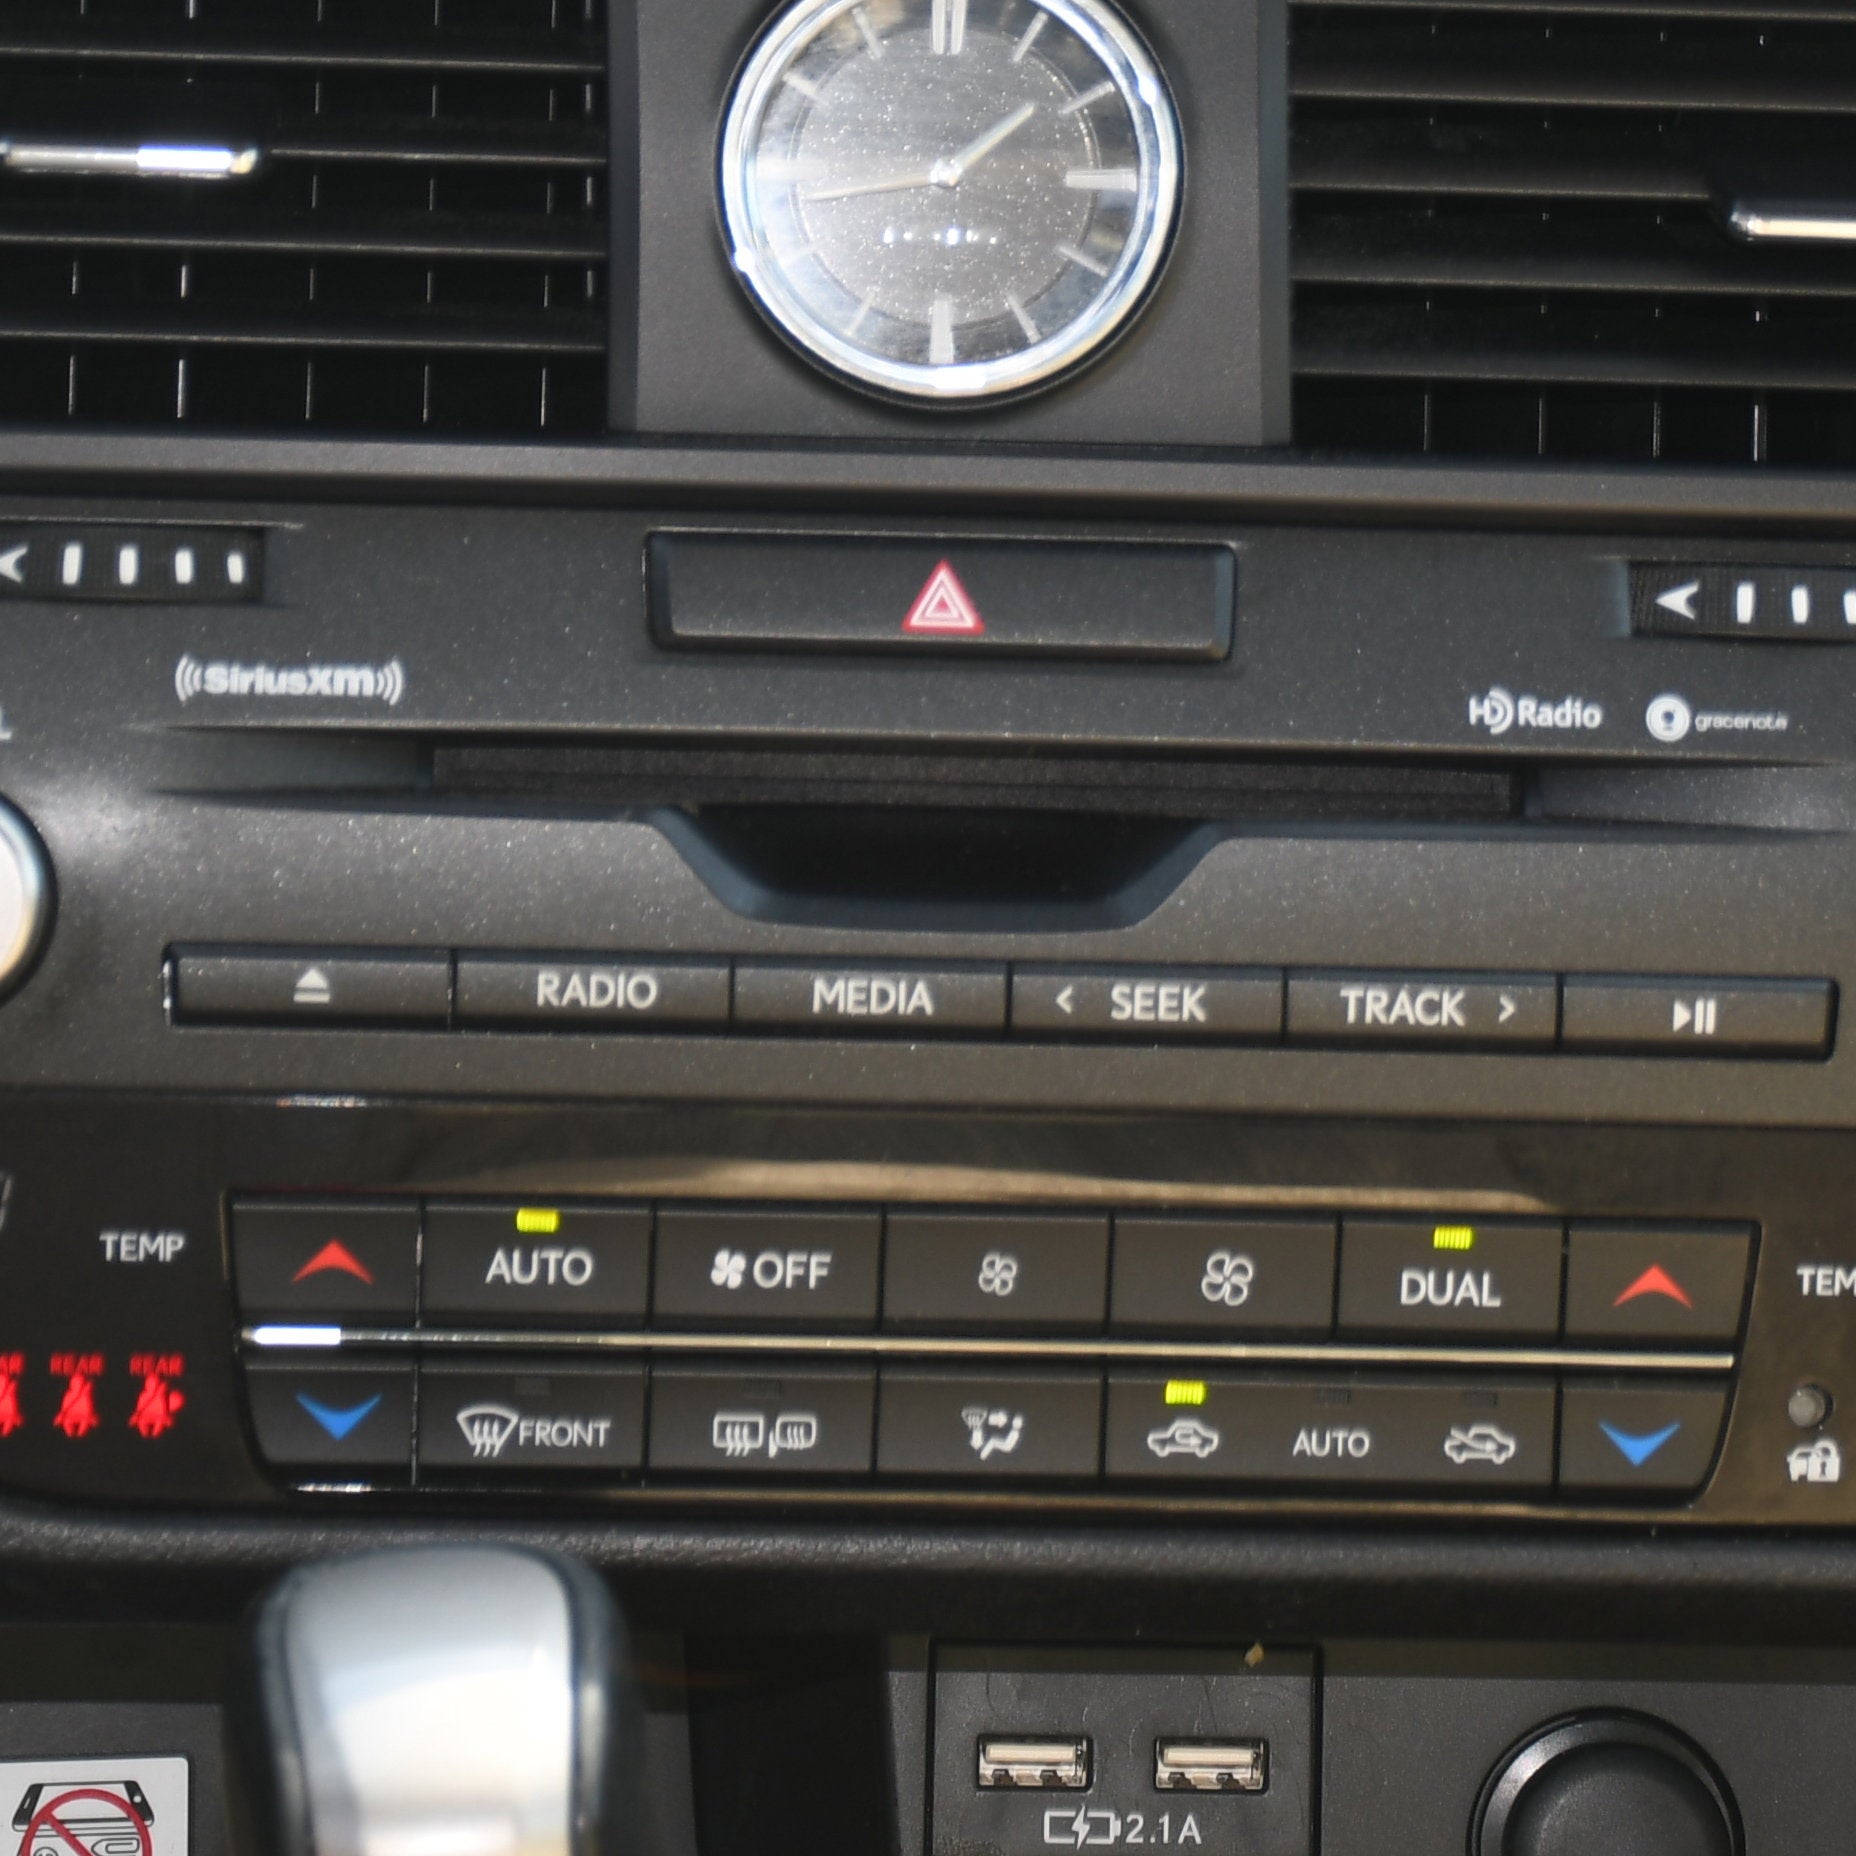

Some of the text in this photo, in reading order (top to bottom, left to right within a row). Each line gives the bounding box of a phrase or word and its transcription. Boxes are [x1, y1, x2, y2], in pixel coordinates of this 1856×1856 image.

[1518, 695, 1603, 729] Radio
[1695, 711, 1788, 732] gracenote
[537, 970, 658, 1010] RADIO
[812, 977, 934, 1017] MEDIA
[1111, 985, 1208, 1022] SEEK
[1341, 986, 1466, 1027] TRACK
[100, 1230, 185, 1263] TEMP
[485, 1248, 593, 1287] AUTO
[752, 1252, 833, 1290] OFF
[1400, 1268, 1501, 1309] DUAL
[49, 1352, 104, 1376] REAR
[129, 1352, 184, 1377] REAR
[518, 1419, 611, 1448] FRONT
[1292, 1428, 1371, 1461] AUTO
[1125, 1812, 1202, 1847] 2.1A
